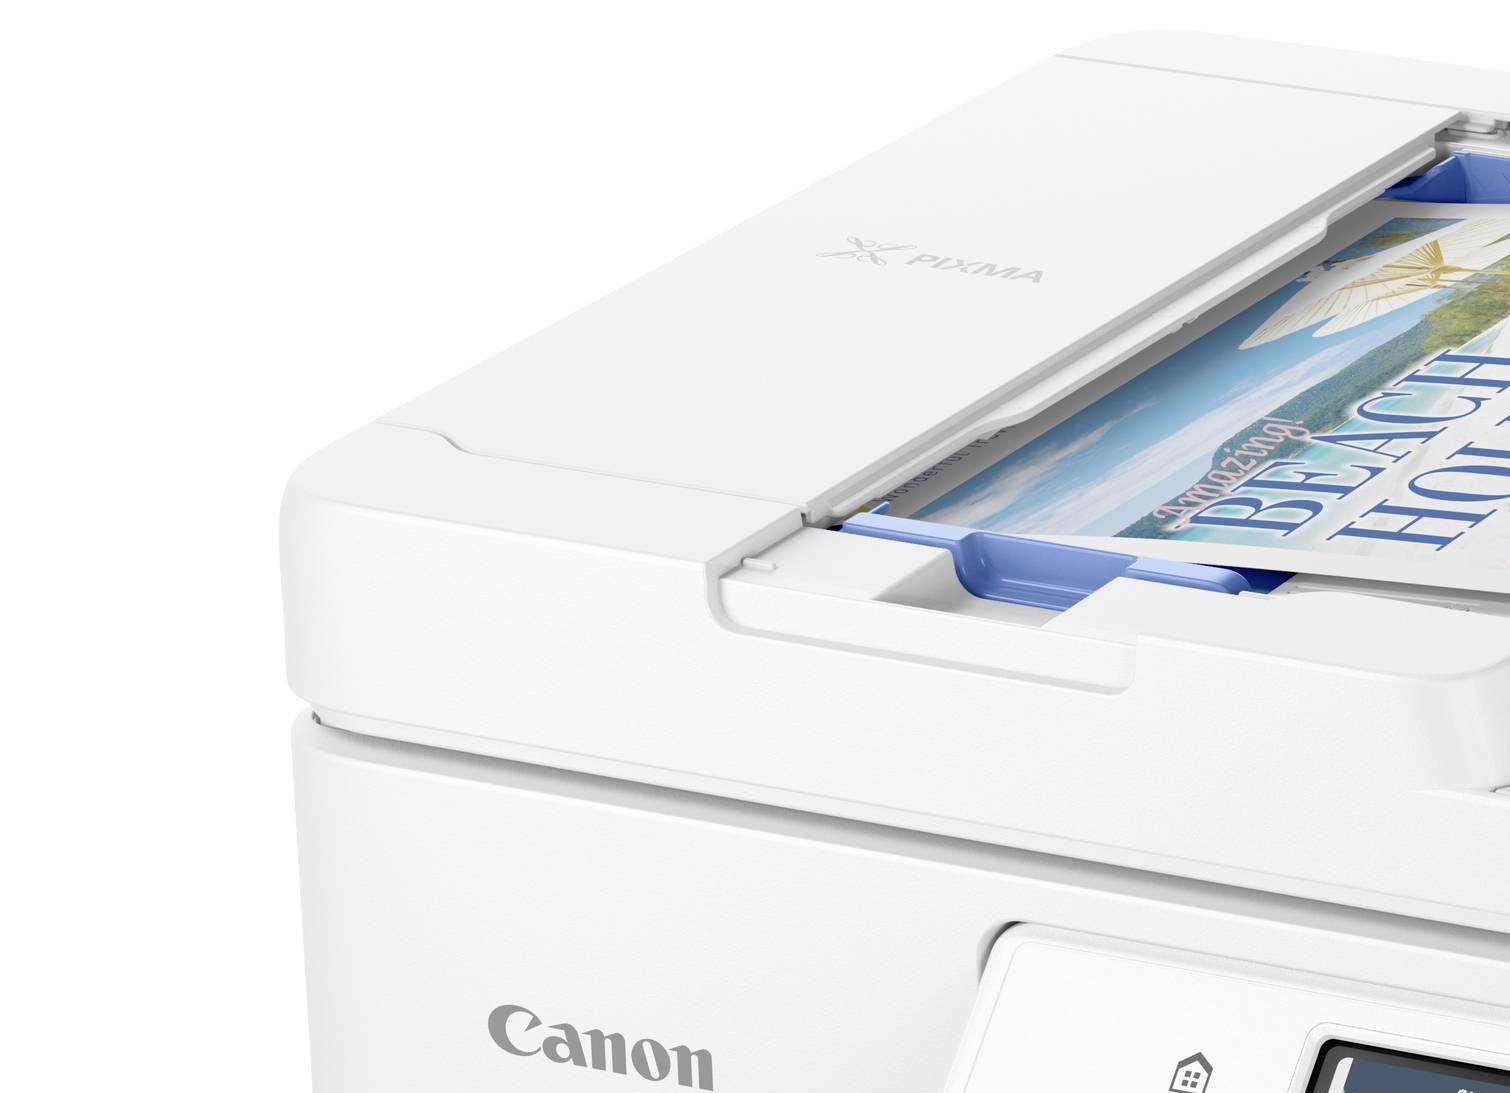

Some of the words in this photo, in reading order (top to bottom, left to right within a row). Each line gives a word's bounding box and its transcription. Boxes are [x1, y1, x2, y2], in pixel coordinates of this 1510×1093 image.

[905, 253, 1044, 283] PIXMA
[1152, 416, 1310, 522] Amazing!
[487, 1004, 714, 1092] Canon
